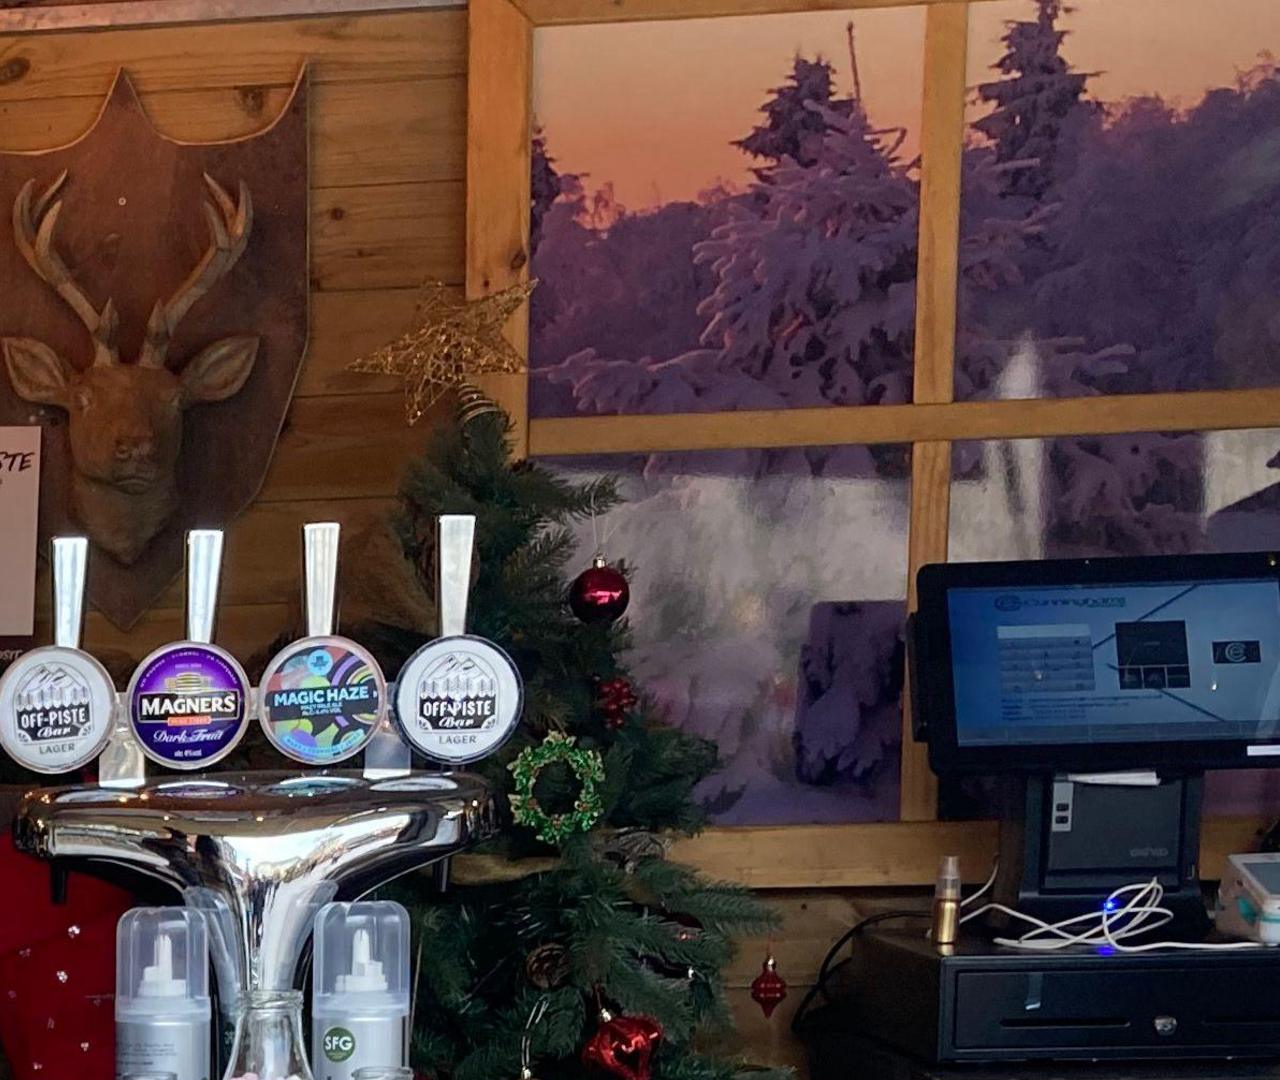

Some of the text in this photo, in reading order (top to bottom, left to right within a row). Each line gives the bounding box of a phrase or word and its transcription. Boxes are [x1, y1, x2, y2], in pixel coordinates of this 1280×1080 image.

[274, 686, 369, 707] MAGIC HAZE
[141, 694, 236, 716] MAGNERS
[423, 700, 492, 717] OFF-PISTE
[20, 707, 86, 730] OFF-PISTE
[438, 716, 475, 729] Bar
[37, 726, 71, 738] Bar
[153, 729, 224, 743] Dark Fruit
[438, 735, 477, 745] LAGER
[39, 743, 75, 755] LAGER
[324, 1036, 353, 1051] SFG
